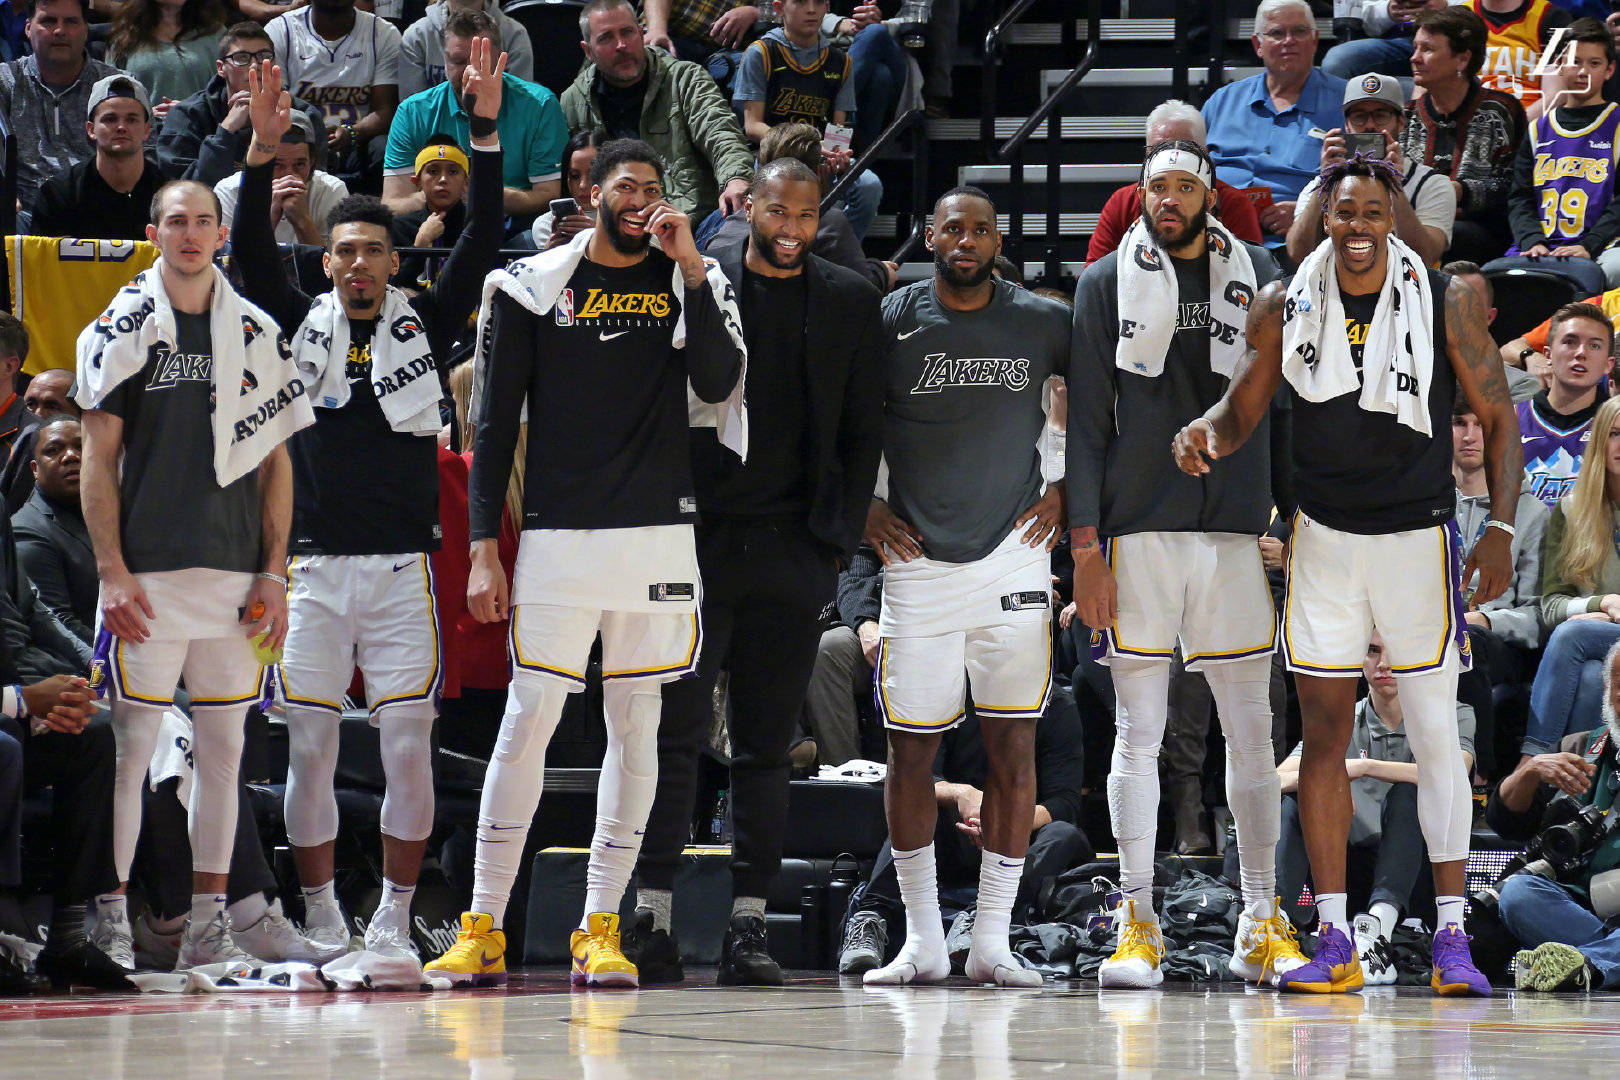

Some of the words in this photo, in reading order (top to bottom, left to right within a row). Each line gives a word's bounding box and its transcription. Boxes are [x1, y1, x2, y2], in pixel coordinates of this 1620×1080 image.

[296, 81, 371, 106] LAKERS
[1533, 153, 1609, 187] LAKERS
[1540, 187, 1588, 238] 39
[575, 288, 671, 318] LAKERS
[910, 352, 1029, 394] LAKERS
